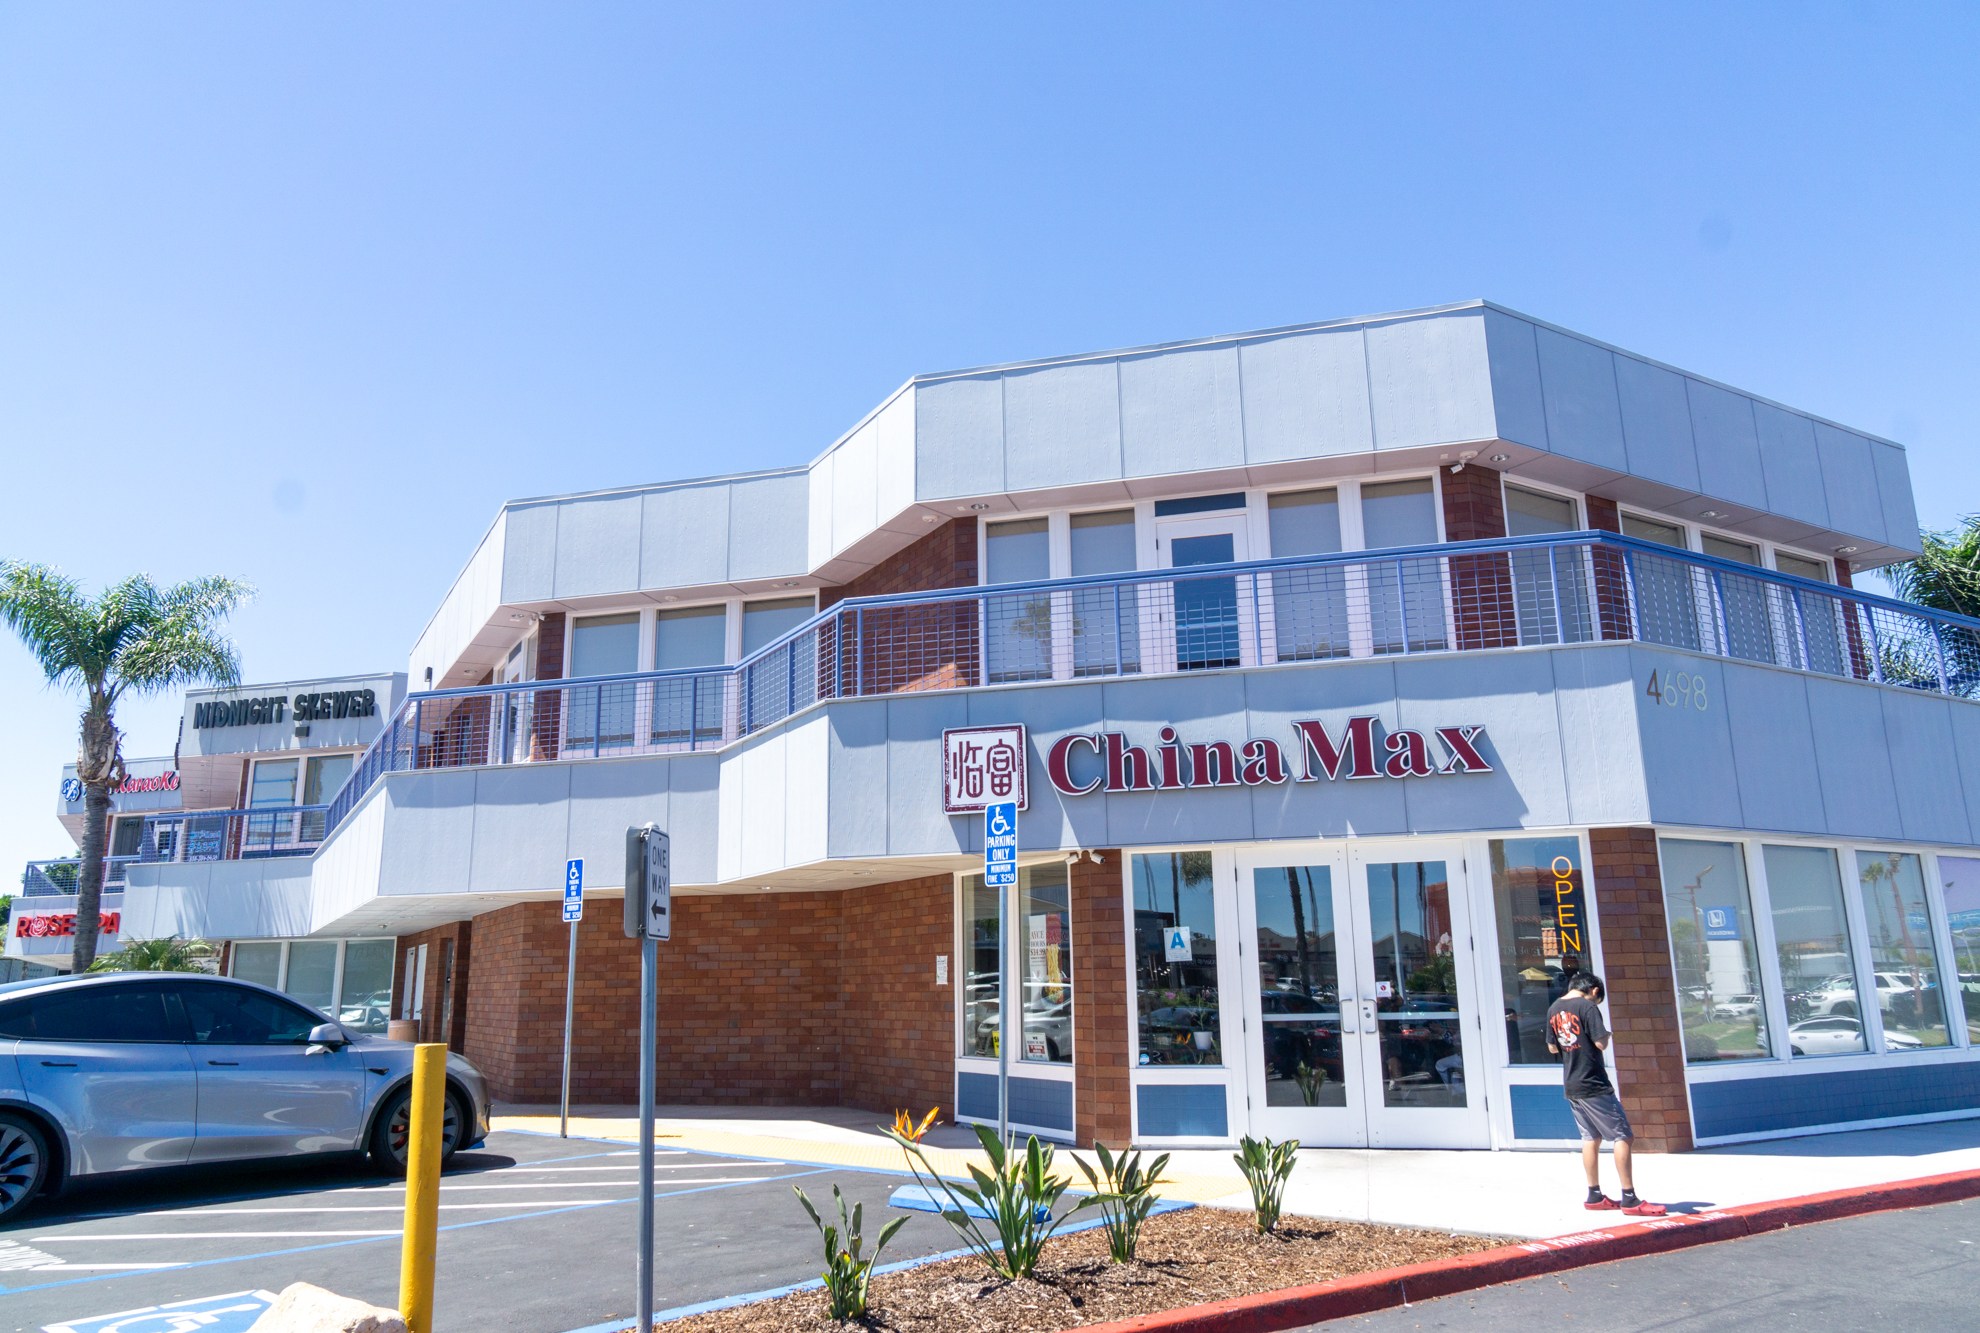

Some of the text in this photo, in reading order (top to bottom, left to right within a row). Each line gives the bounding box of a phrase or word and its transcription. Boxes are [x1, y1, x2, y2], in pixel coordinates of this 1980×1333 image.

[1647, 667, 1708, 711] 4698
[193, 688, 376, 729] MIDNIGHT SKEWER
[987, 833, 1015, 849] PARKING
[652, 845, 667, 869] ONE
[992, 848, 1010, 861] ONLY
[987, 872, 1015, 884] FINE $250
[990, 864, 1012, 873] MINIMUM
[651, 873, 667, 896] WAY
[1551, 855, 1581, 954] OPEN
[1170, 931, 1186, 949] A
